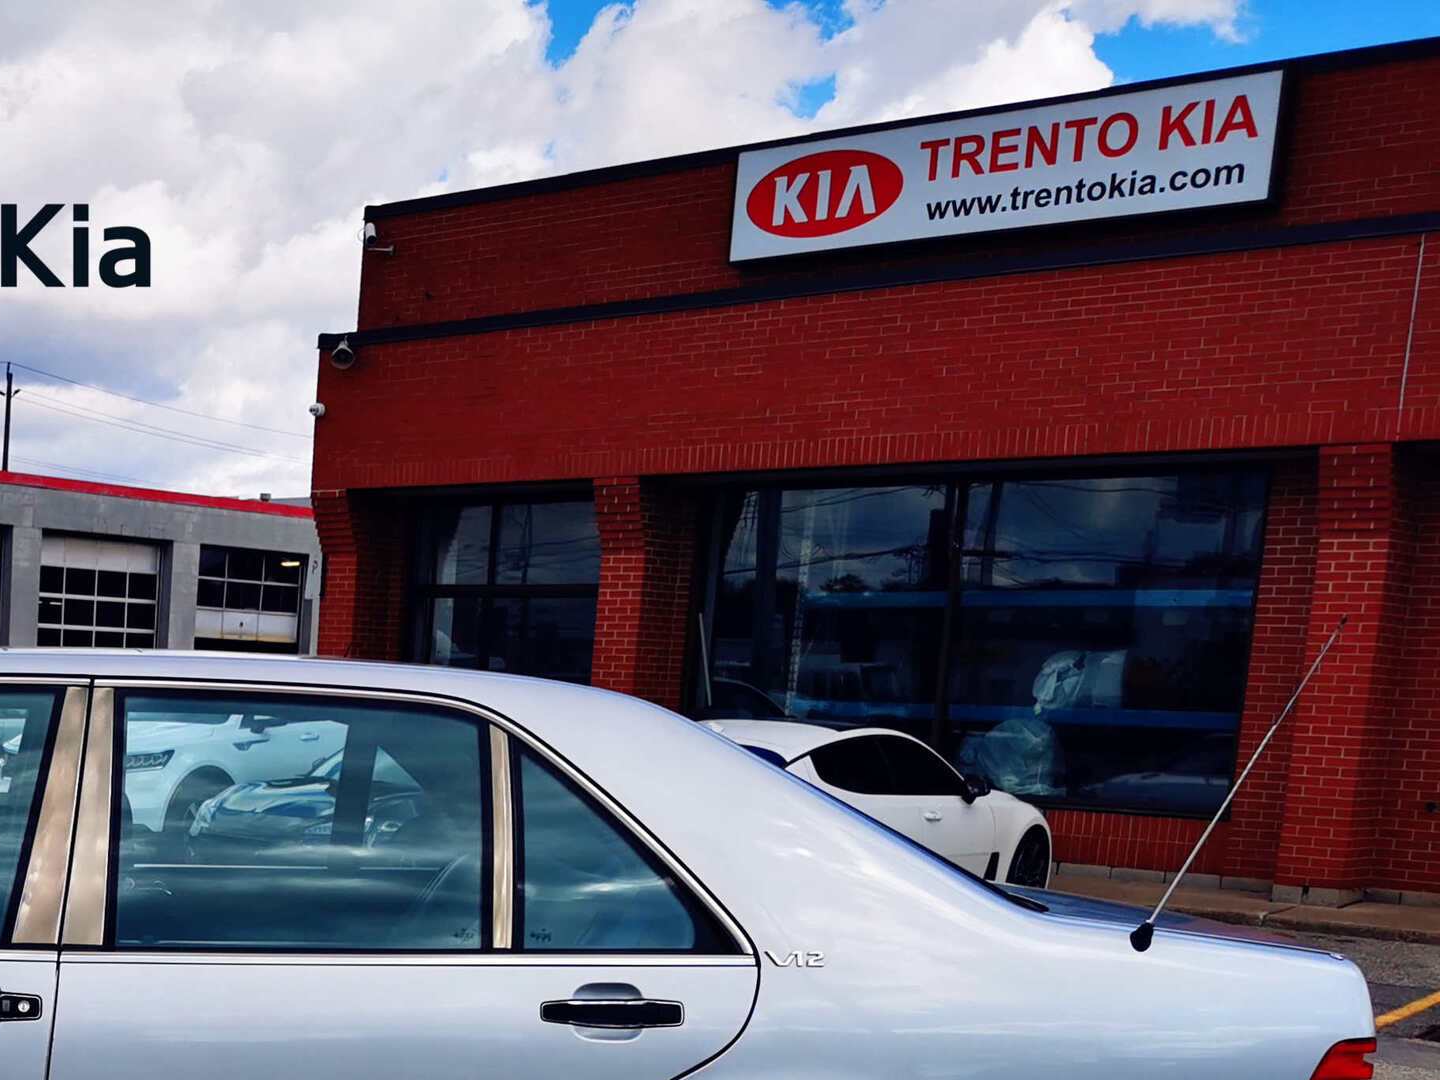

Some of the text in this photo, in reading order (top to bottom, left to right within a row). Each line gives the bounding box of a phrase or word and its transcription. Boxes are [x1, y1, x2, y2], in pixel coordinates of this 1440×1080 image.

[920, 94, 1259, 182] TRENTO KIA
[771, 164, 877, 226] KIA
[925, 162, 1246, 221] www.trentokia.com
[763, 950, 825, 968] V12
